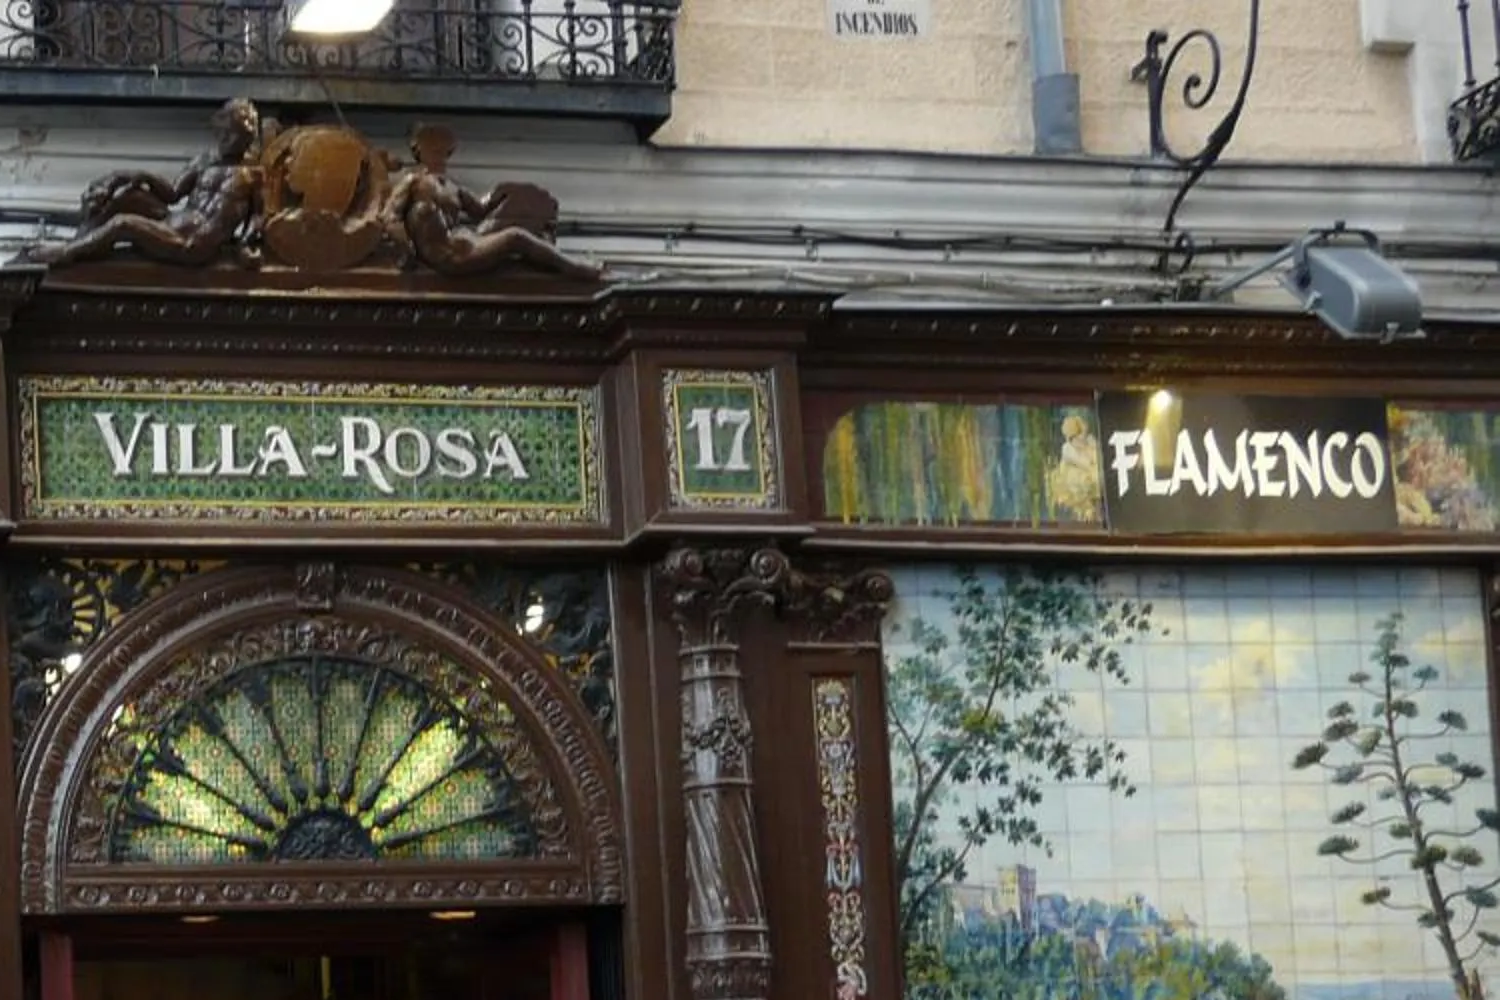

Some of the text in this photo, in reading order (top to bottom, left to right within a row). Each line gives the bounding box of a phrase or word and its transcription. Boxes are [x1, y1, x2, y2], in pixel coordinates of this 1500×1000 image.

[835, 11, 918, 36] INCENDIOS
[686, 407, 752, 471] 17
[1108, 428, 1385, 498] FLAMENCO
